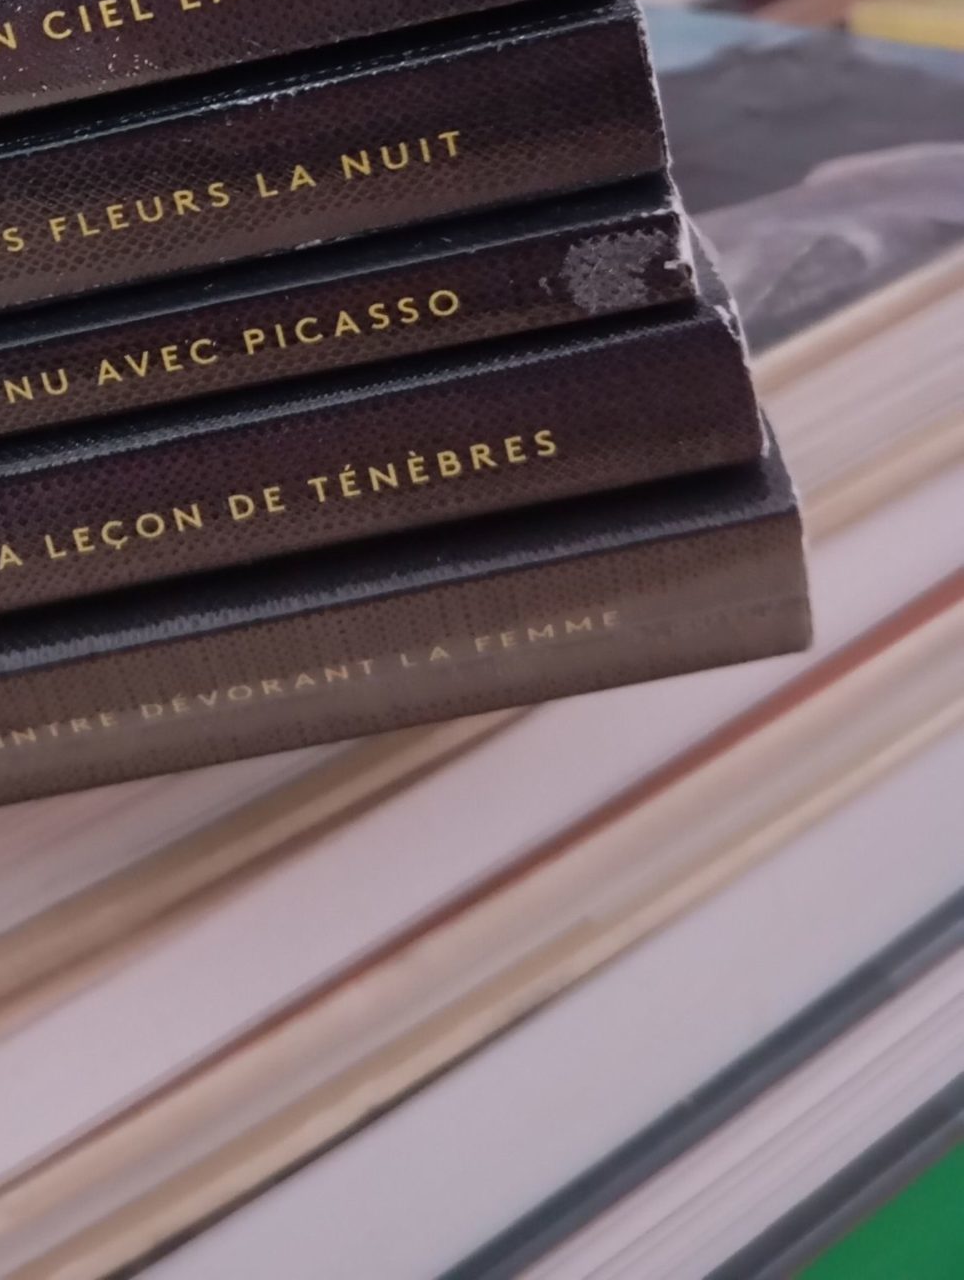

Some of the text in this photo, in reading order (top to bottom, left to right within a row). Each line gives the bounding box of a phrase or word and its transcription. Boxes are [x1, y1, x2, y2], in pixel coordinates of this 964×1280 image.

[49, 181, 231, 243] FLEURS
[254, 164, 317, 199] LA
[340, 131, 463, 180] NUIT
[4, 289, 461, 404] NU AVEC PICASSO
[46, 504, 204, 550] LEÇON
[229, 487, 285, 521] DE
[308, 429, 559, 504] TÉNÈBRES
[140, 658, 375, 720] DÉVORANT
[400, 646, 451, 667] LA
[474, 609, 622, 655] FEMME
